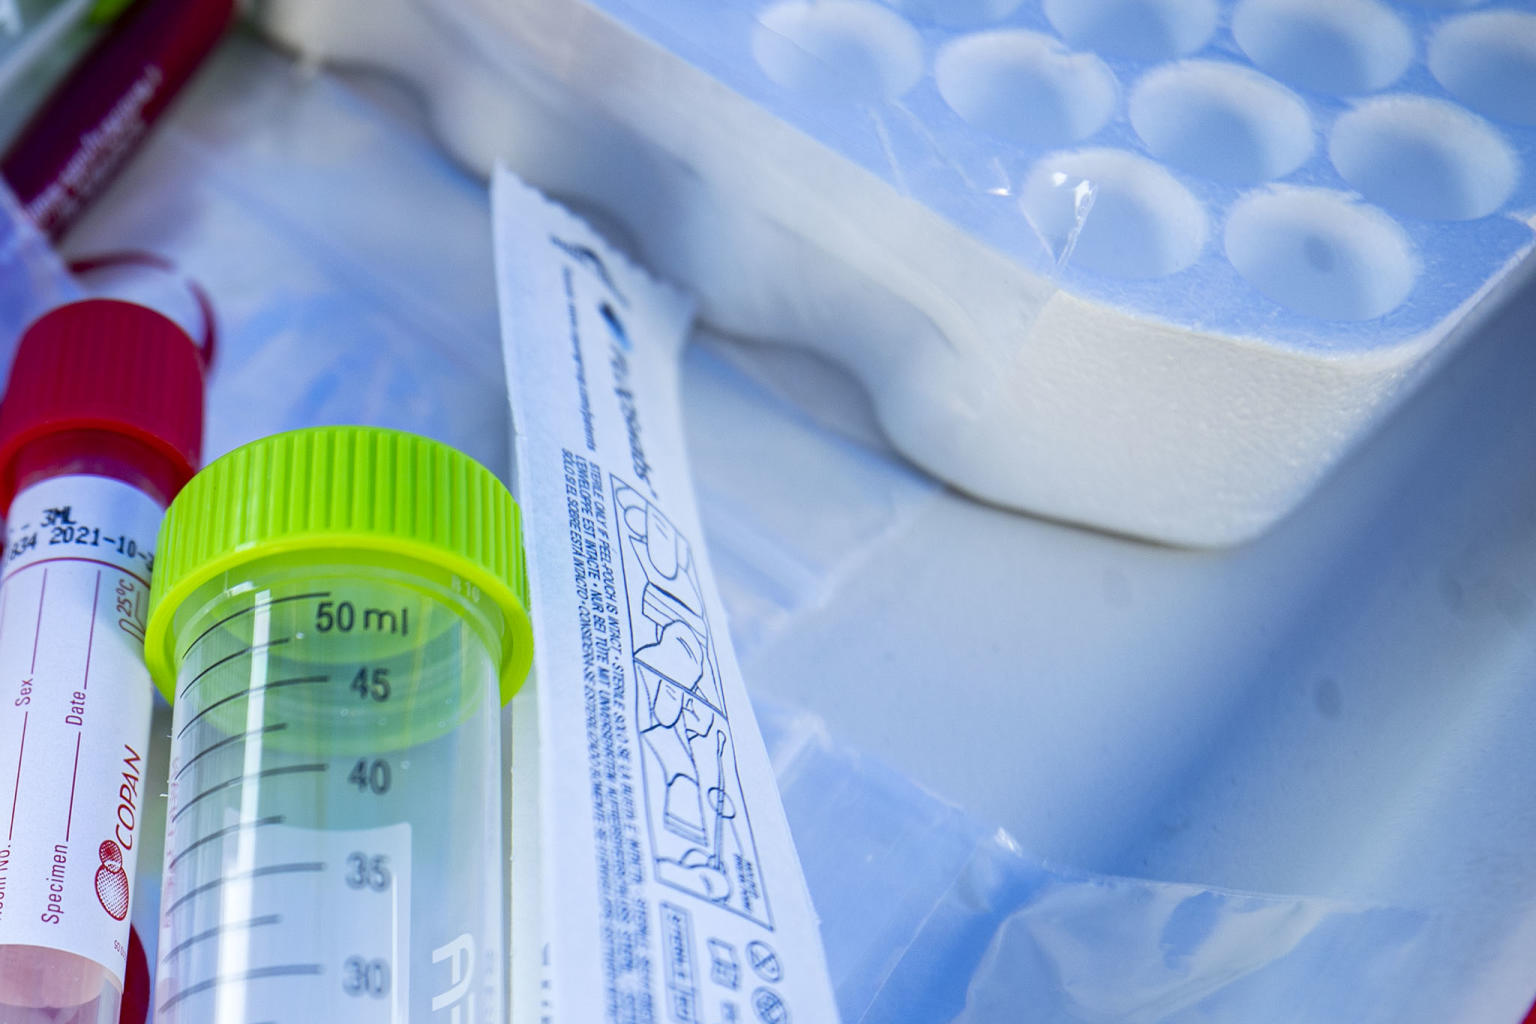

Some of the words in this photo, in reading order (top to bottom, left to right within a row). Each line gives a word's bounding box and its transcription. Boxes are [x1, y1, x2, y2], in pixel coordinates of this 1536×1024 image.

[567, 496, 582, 533] SOBRE
[582, 516, 595, 540] EST
[573, 555, 589, 602] INTACTO
[585, 540, 601, 582] INTACTE
[594, 500, 607, 529] ONLY
[608, 616, 622, 656] INTACT
[314, 600, 355, 634] 50
[363, 606, 409, 636] ml
[590, 590, 605, 615] NUR
[593, 612, 607, 635] BEI
[15, 678, 34, 707] Sex
[349, 666, 392, 702] 45
[65, 691, 87, 727] Date
[347, 757, 392, 796] 40
[115, 744, 142, 851] COPAN
[41, 844, 69, 925] Specimen
[344, 851, 391, 892] 35
[341, 955, 393, 998] 30
